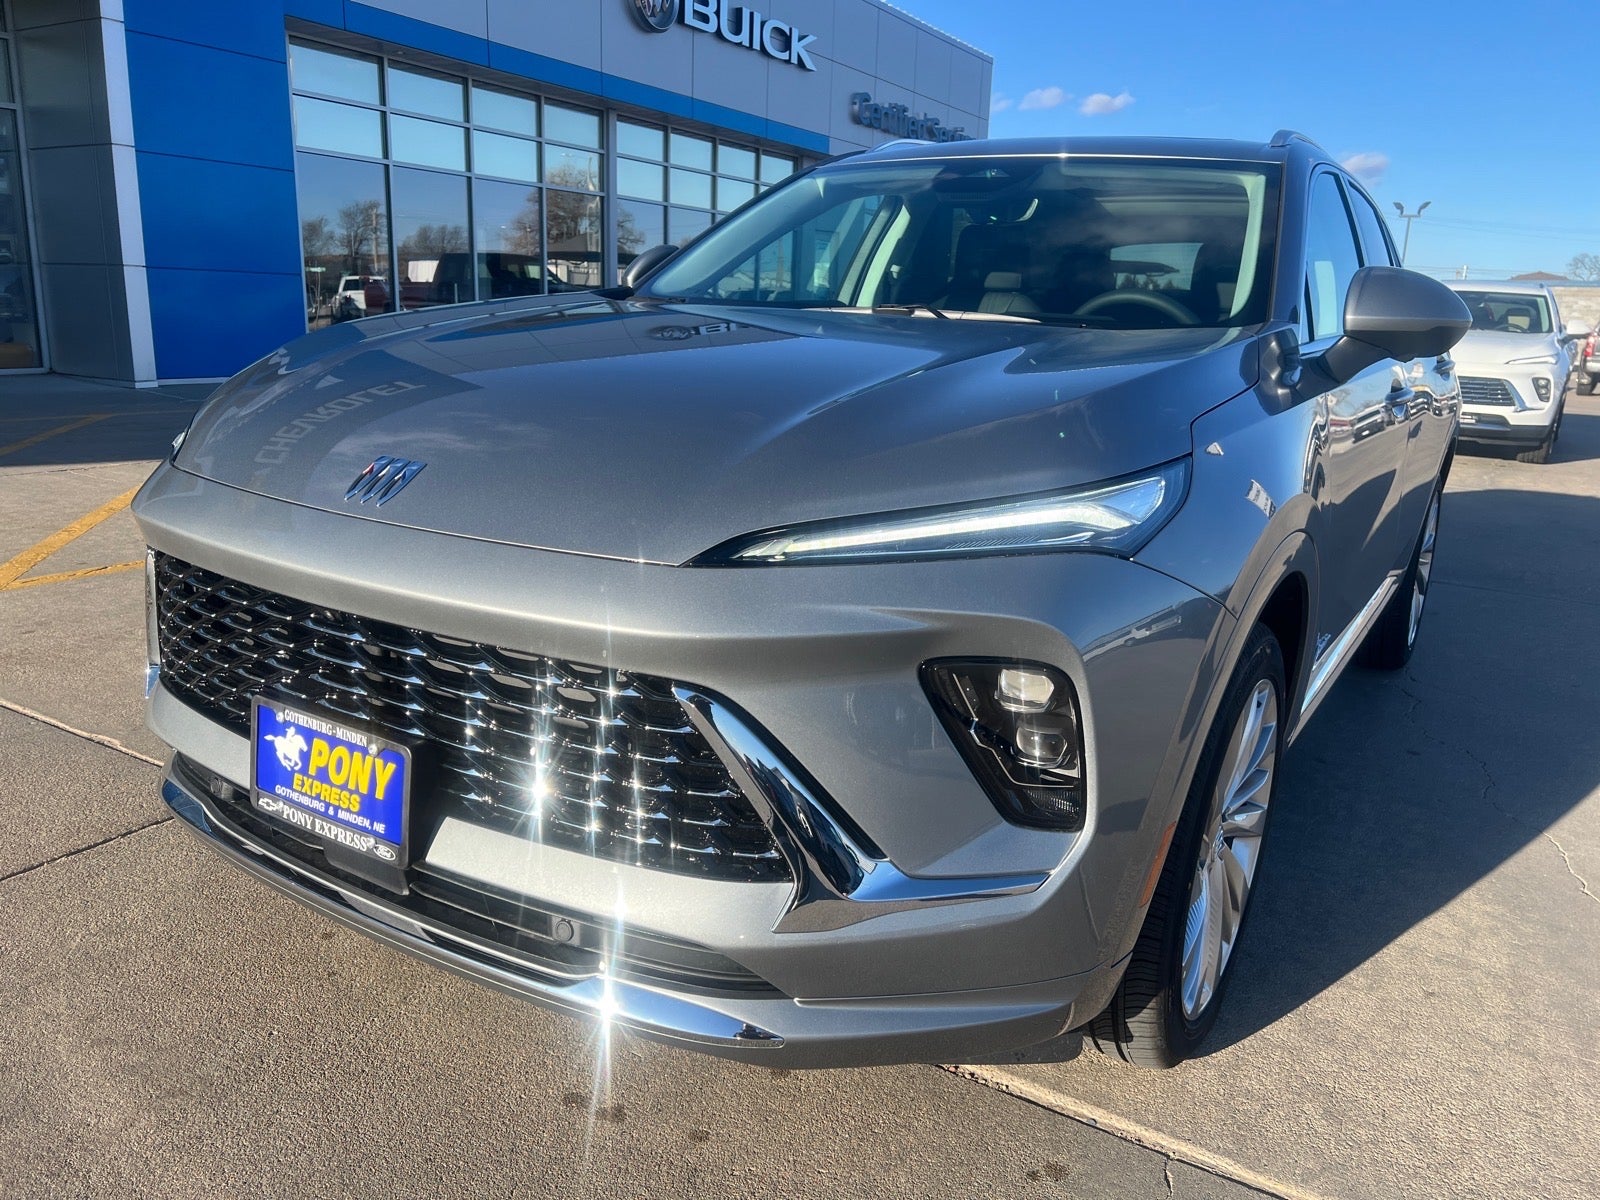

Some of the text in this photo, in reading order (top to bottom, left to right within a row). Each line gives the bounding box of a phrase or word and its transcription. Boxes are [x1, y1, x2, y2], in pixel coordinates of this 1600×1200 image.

[684, 0, 818, 71] BUICK
[293, 773, 361, 812] EXPRESS
[308, 737, 396, 800] PONY
[275, 785, 386, 834] GOTHENBURG & MINDEN, NE
[283, 804, 367, 851] PONY EXPRESS
